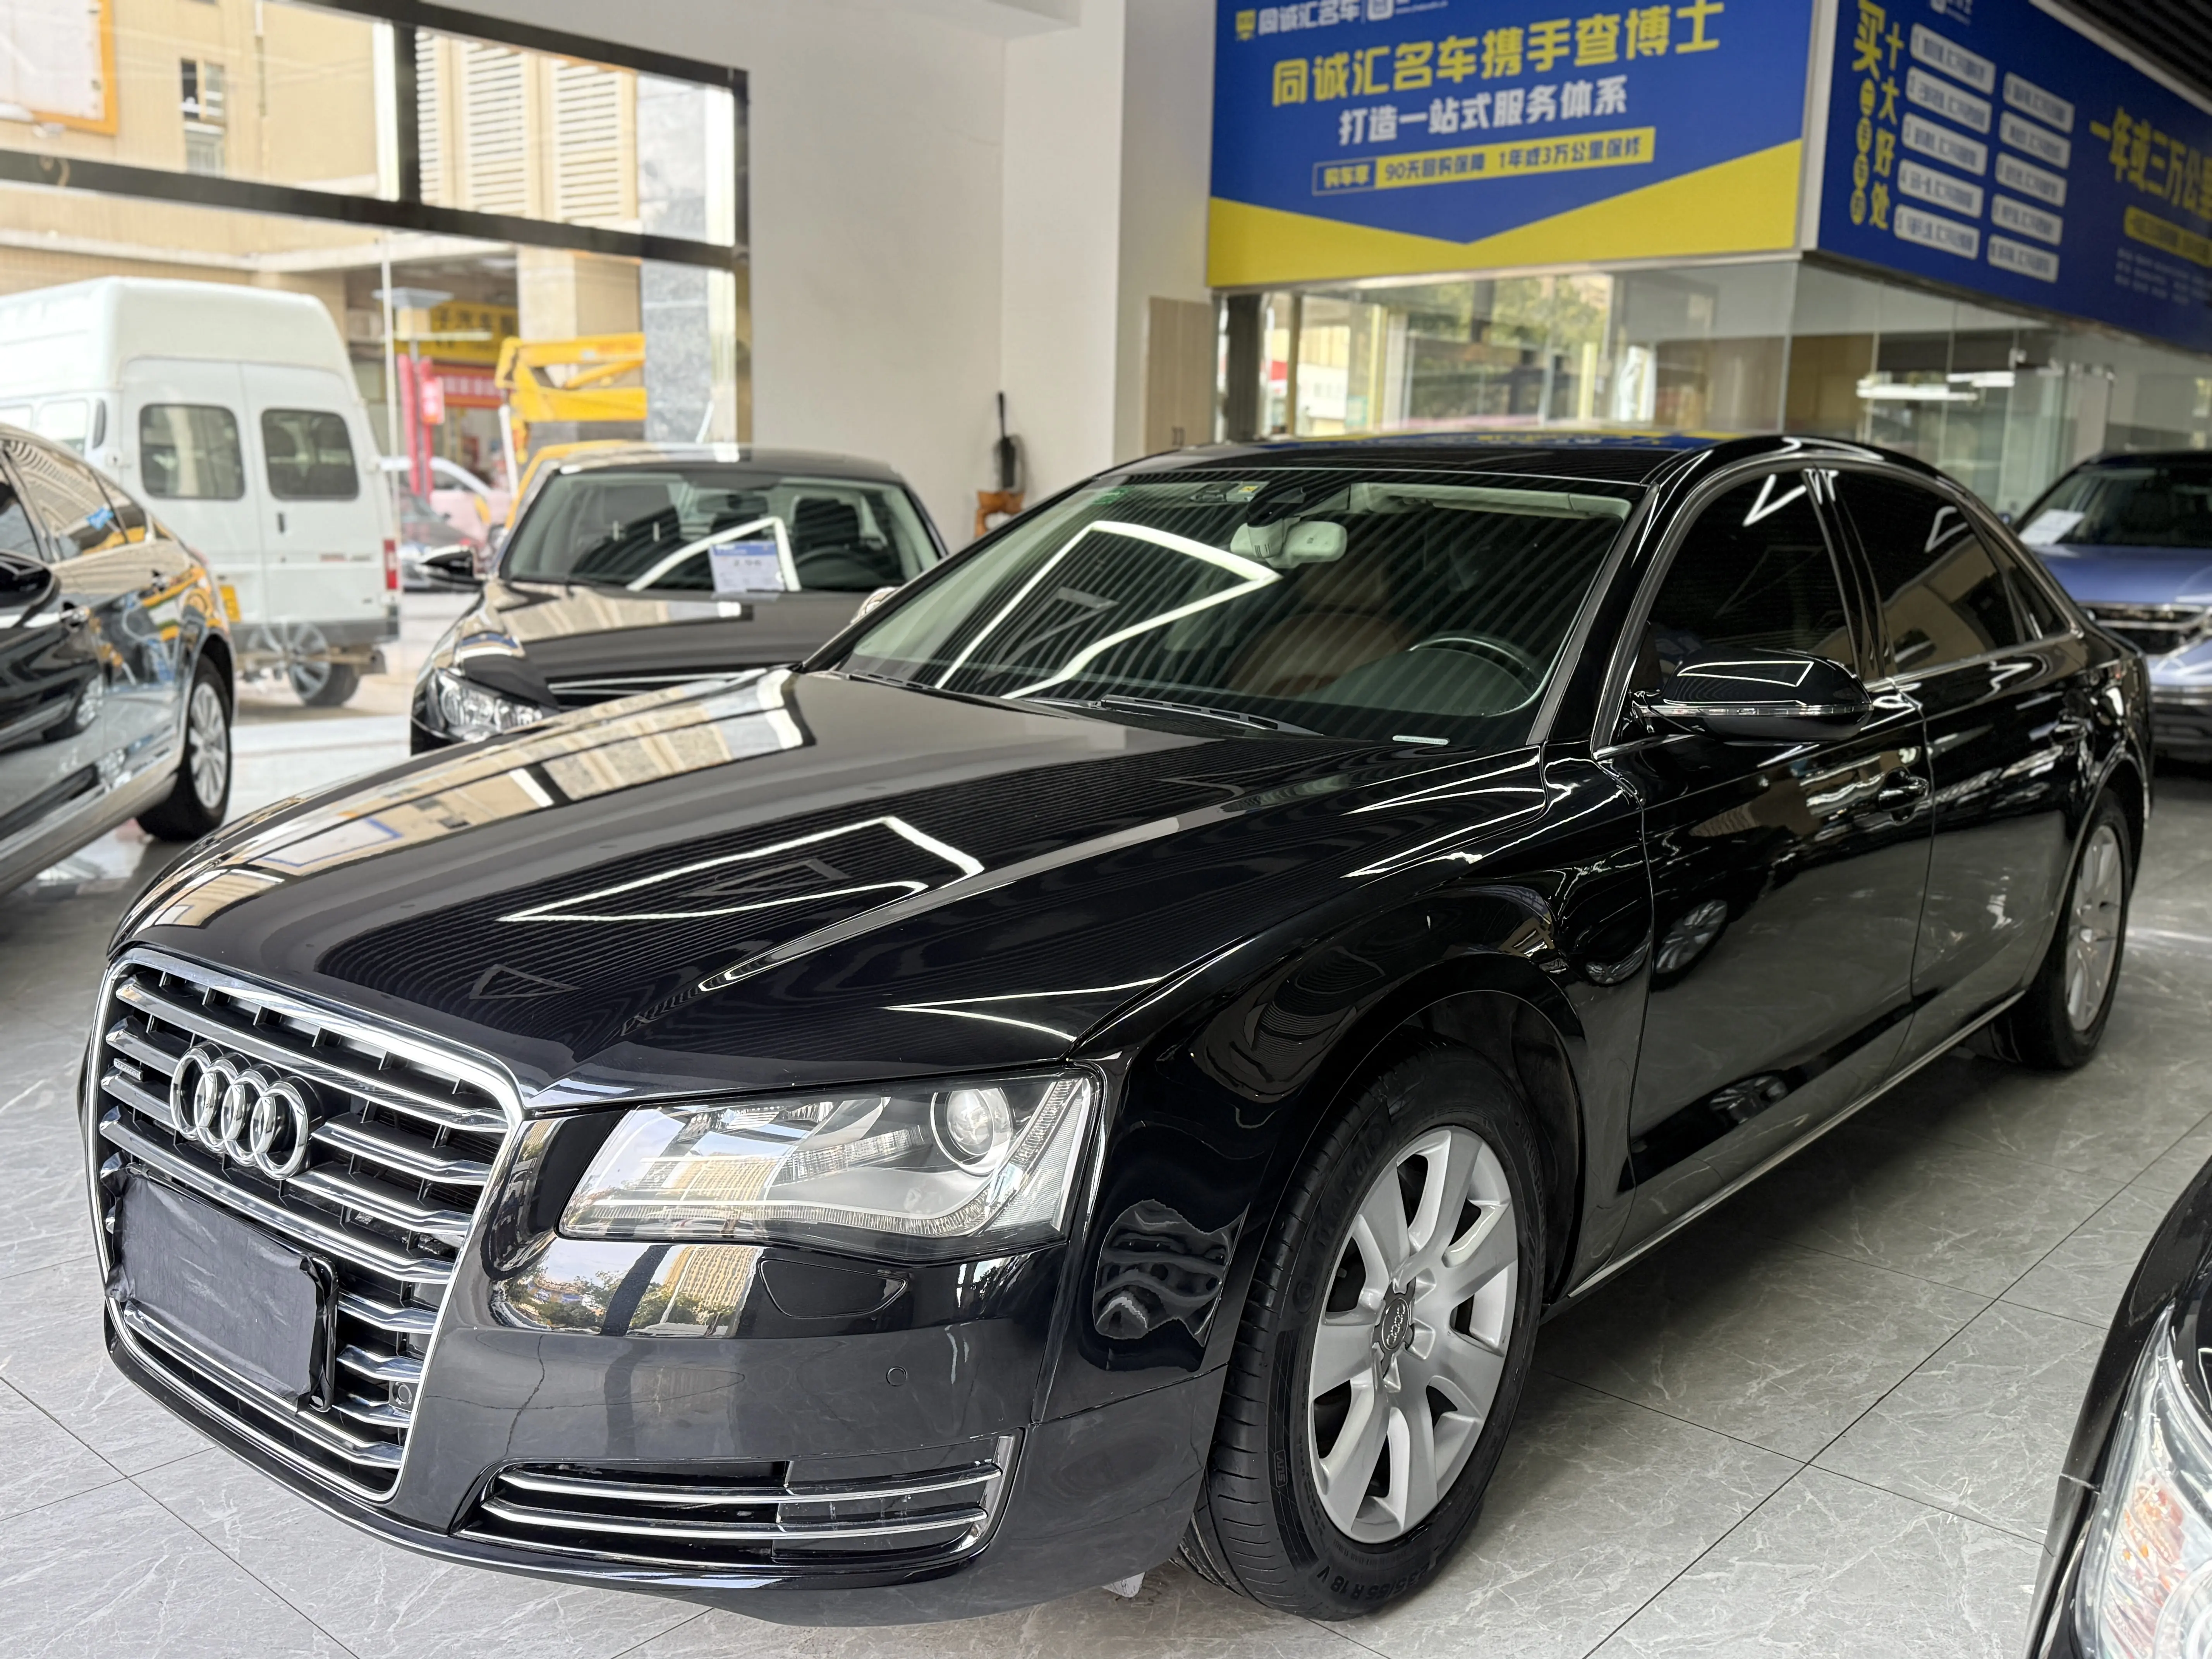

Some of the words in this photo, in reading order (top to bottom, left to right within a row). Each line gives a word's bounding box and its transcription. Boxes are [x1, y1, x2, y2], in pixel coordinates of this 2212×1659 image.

[1273, 0, 1724, 106] 同诚汇名车携手查博士
[1340, 75, 1627, 145] 打造一站式服务体系
